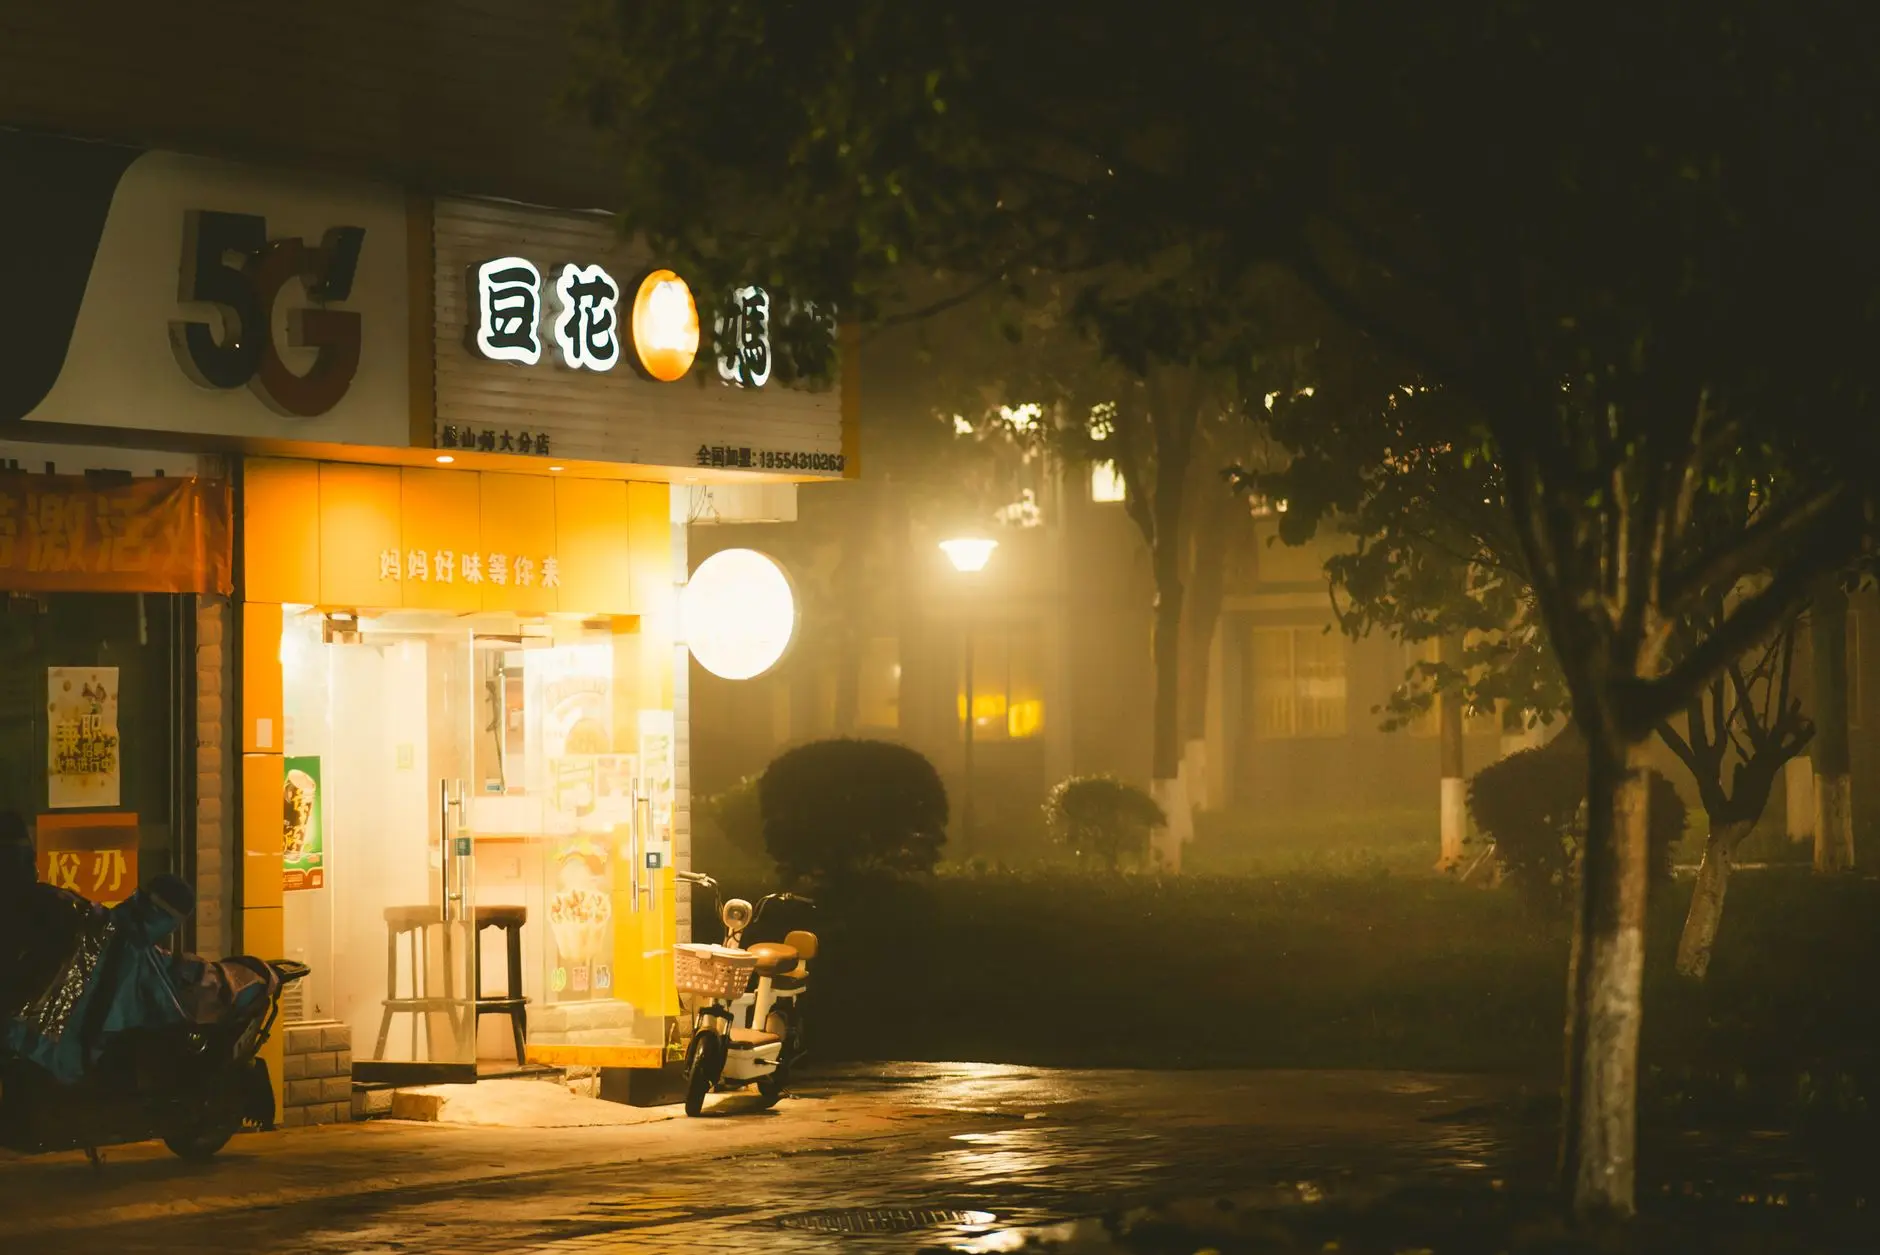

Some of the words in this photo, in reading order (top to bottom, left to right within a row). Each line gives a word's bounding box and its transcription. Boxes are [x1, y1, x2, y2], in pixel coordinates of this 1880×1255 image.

[168, 209, 366, 418] 5G
[477, 256, 620, 372] 豆花
[379, 549, 561, 588] 妈妈好味等你来
